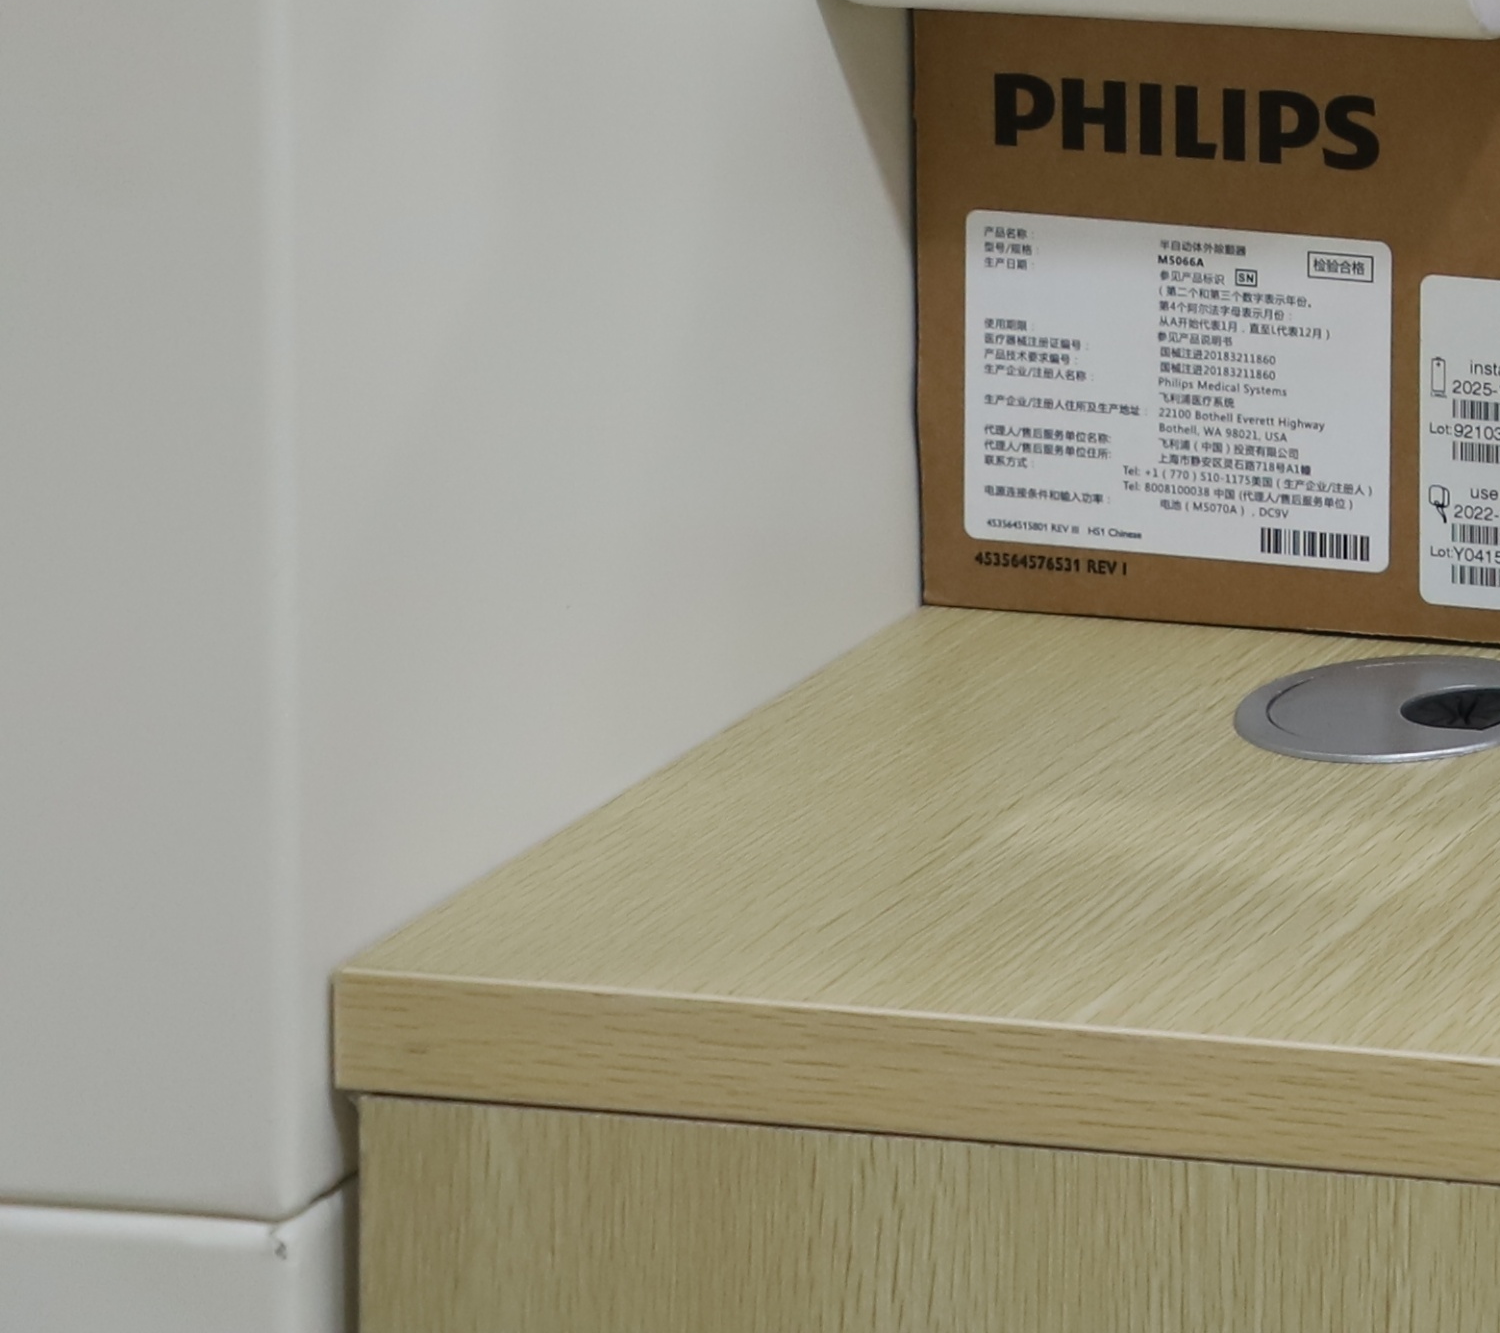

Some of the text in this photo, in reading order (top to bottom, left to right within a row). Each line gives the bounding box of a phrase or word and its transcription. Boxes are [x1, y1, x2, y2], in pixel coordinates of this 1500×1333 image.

[994, 73, 1380, 170] PHILIPS
[1158, 255, 1204, 267] M5066A
[1313, 258, 1364, 275] 检验合格
[1238, 270, 1254, 285] SN
[1158, 377, 1196, 392] Philips
[1198, 381, 1240, 396] Medical
[1244, 384, 1287, 397] Systems
[1159, 407, 1194, 419] 22100
[1194, 411, 1233, 422] Bothell
[1237, 414, 1274, 426] Everett
[1278, 418, 1325, 432] Highway
[1204, 427, 1221, 436] WA
[1265, 432, 1287, 442] USA
[1123, 465, 1140, 475] Tel:
[1123, 481, 1140, 491] Tel:
[1145, 482, 1209, 496] 8008100038
[1471, 488, 1498, 500] use
[1051, 523, 1069, 533] REV
[974, 551, 1080, 572] 453564576531
[1087, 559, 1117, 575] REV
